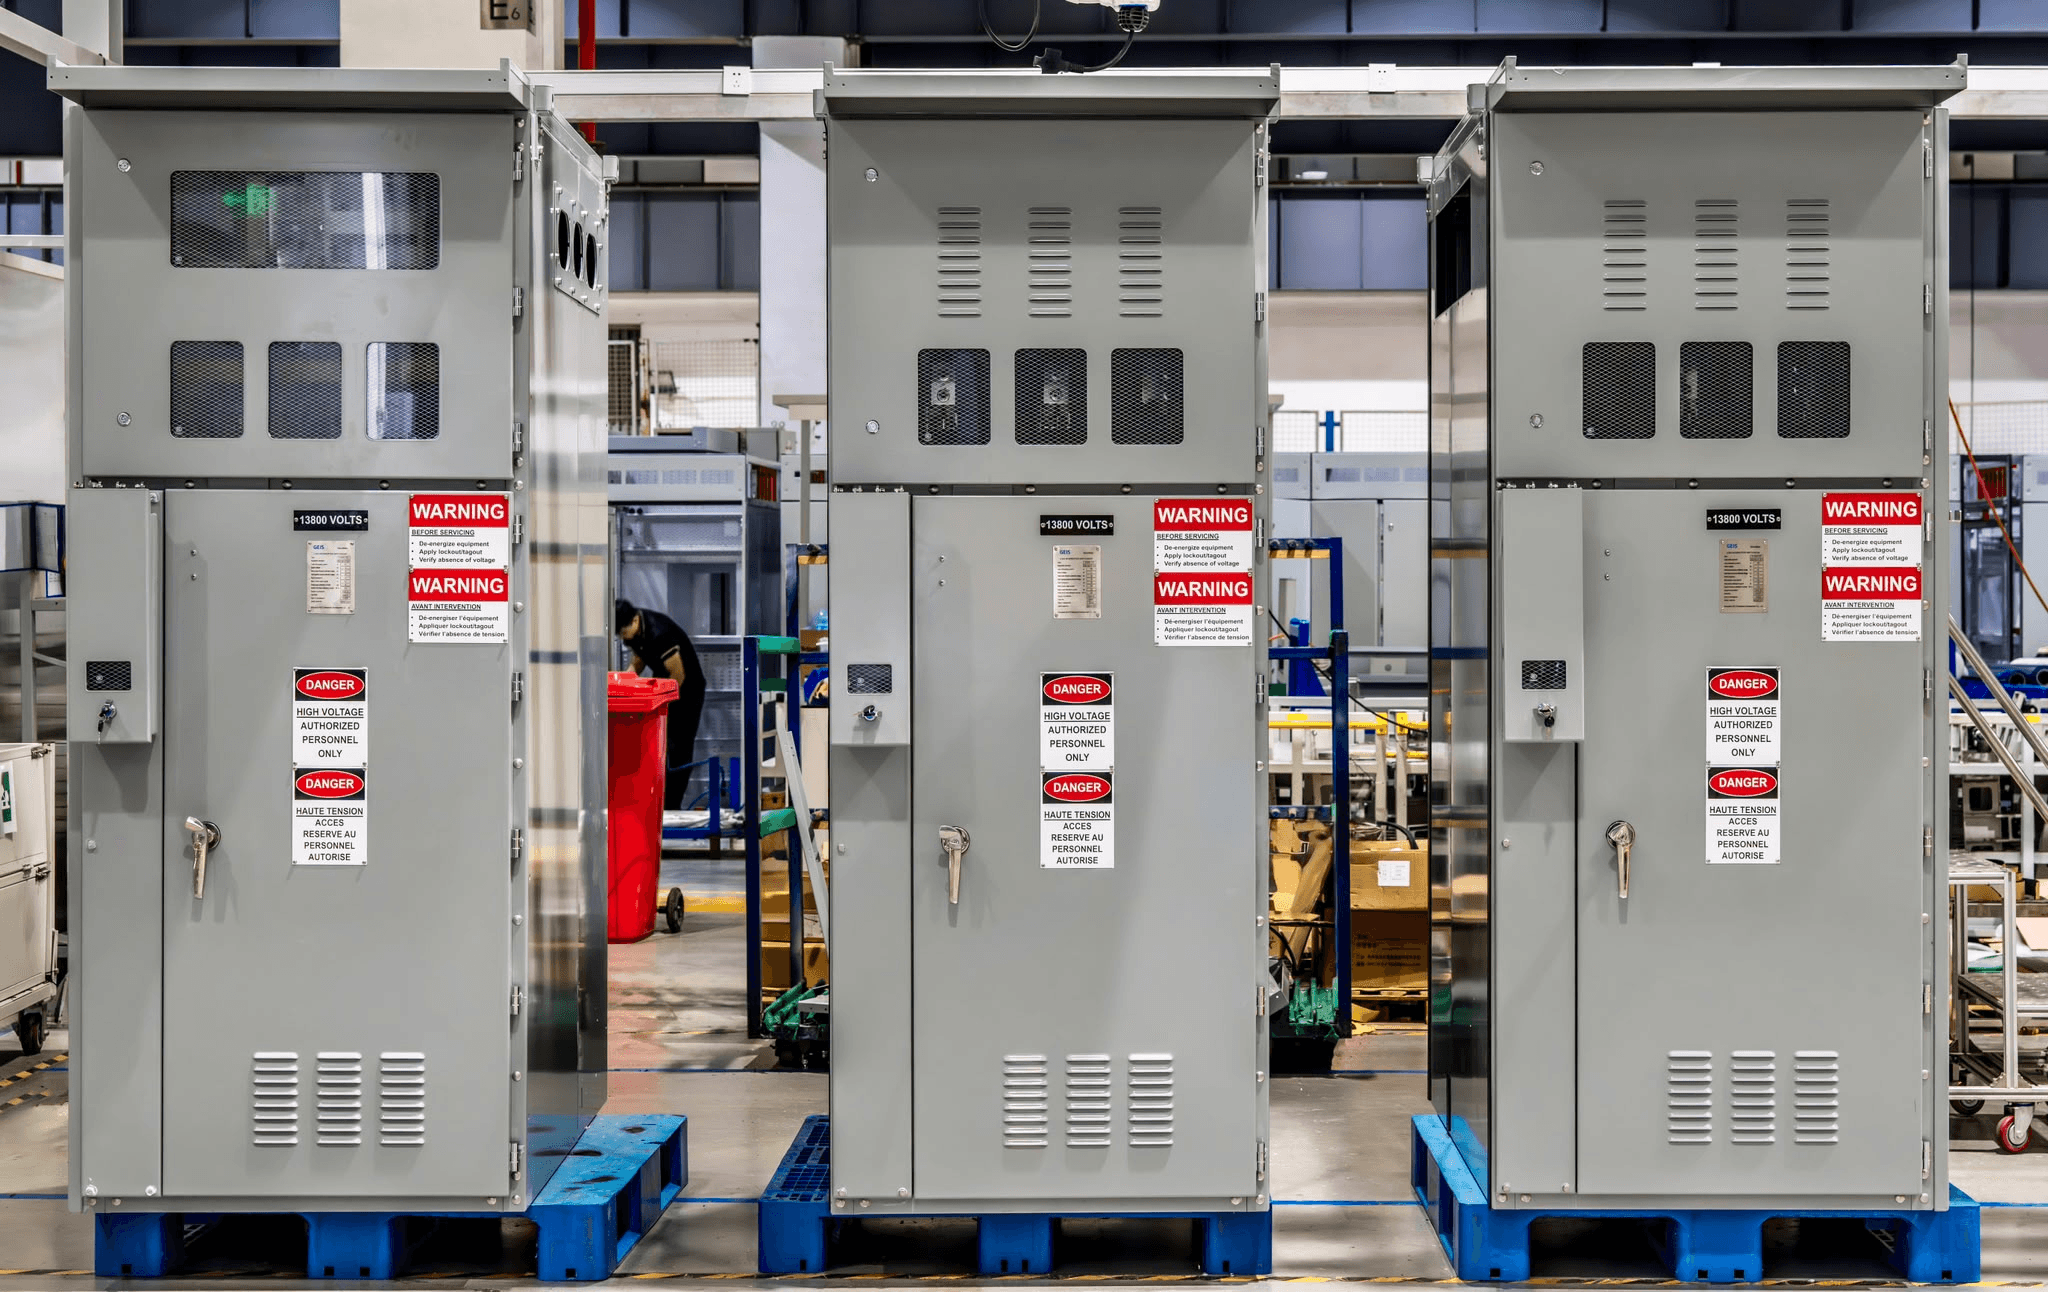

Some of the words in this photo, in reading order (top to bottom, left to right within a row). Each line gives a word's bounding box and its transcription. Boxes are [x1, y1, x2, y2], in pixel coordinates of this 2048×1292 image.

[413, 503, 505, 520] WARNING
[1825, 501, 1917, 518] WARNING
[1158, 507, 1248, 523] WARNING
[1712, 514, 1740, 524] 13800
[1742, 514, 1776, 524] VOLTS
[299, 515, 327, 525] 13800
[329, 515, 362, 525] VOLTS
[1046, 520, 1073, 529] 13800
[1075, 520, 1108, 529] VOLTS
[413, 577, 504, 594] WARNING
[1825, 576, 1917, 592] WARNING
[1158, 581, 1249, 597] WARNING
[1164, 618, 1203, 626] Dé-energiser
[305, 680, 355, 690] DANGER
[1719, 678, 1768, 689] DANGER
[1053, 684, 1102, 695] DANGER
[296, 708, 319, 716] HIGH
[321, 707, 364, 716] VOLTAGE
[1710, 707, 1733, 715] HIGH
[1734, 706, 1777, 715] VOLTAGE
[1044, 712, 1066, 720] HIGH
[1068, 711, 1111, 720] VOLTAGE
[300, 722, 360, 730] AUTHORIZED
[1714, 721, 1773, 729] AUTHORIZED
[1048, 726, 1107, 734] AUTHORIZED
[302, 736, 359, 744] PERSONNEL
[1715, 735, 1771, 743] PERSONNEL
[1049, 740, 1106, 748] PERSONNEL
[318, 749, 343, 758] ONLY
[1731, 748, 1756, 757] ONLY
[1065, 753, 1090, 762] ONLY
[305, 778, 354, 789] DANGER
[1719, 777, 1768, 788] DANGER
[1053, 782, 1102, 793] DANGER
[296, 807, 325, 815] HAUTE
[327, 807, 364, 815] TENSION
[1709, 806, 1738, 814] HAUTE
[1740, 806, 1777, 814] TENSION
[1044, 811, 1072, 819] HAUTE
[1074, 811, 1111, 819] TENSION
[315, 819, 344, 827] ACCES
[1063, 822, 1092, 830] ACCES
[1728, 818, 1758, 826] ACCES
[303, 830, 343, 838] RESERVE
[344, 830, 357, 838] AU
[1717, 829, 1756, 837] RESERVE
[1757, 829, 1770, 837] AU
[1051, 834, 1090, 842] RESERVE
[1092, 834, 1104, 842] AU
[1717, 840, 1769, 848] PERSONNEL
[1052, 845, 1103, 853] PERSONNEL
[308, 853, 351, 861] AUTORISE
[1722, 852, 1764, 860] AUTORISE
